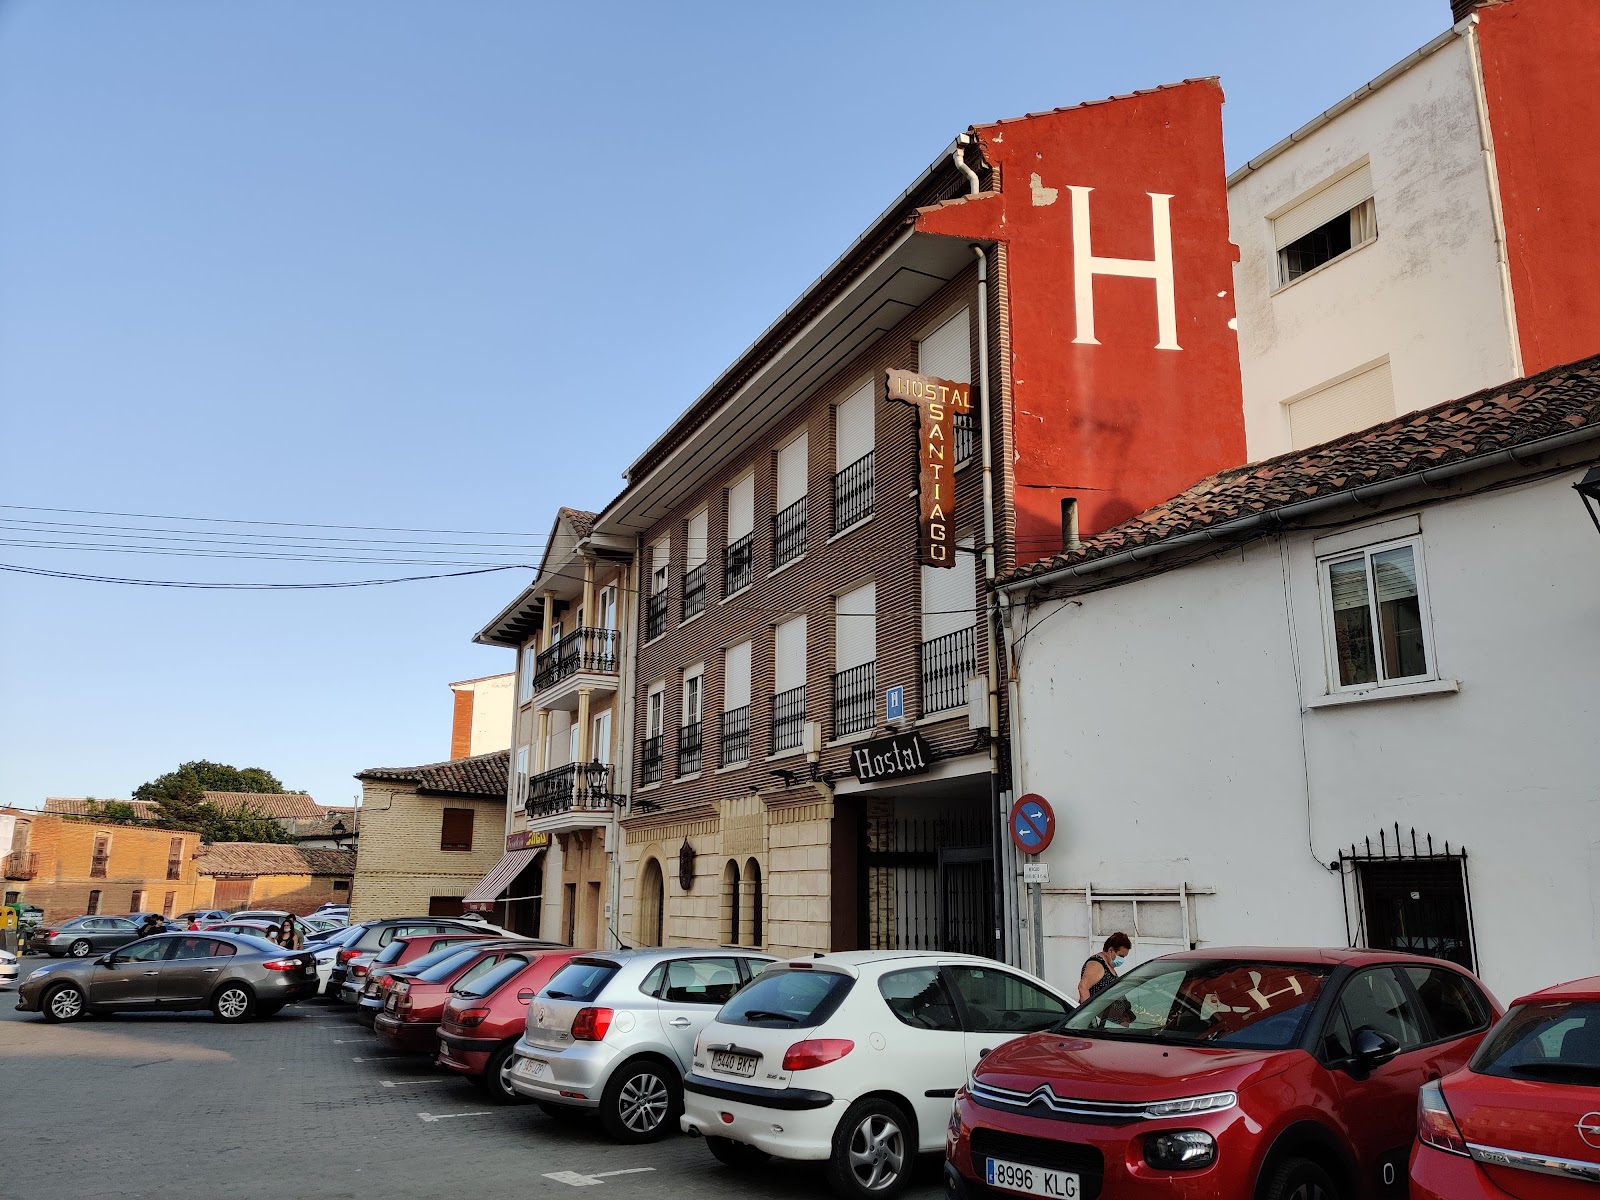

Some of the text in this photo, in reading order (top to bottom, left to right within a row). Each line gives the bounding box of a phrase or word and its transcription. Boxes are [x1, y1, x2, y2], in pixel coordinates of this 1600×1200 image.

[1066, 185, 1184, 350] H
[897, 377, 975, 409] HOSTAL
[929, 403, 946, 561] SANTIAGO
[853, 736, 926, 779] Hostal
[717, 1053, 735, 1070] 5440
[736, 1056, 755, 1073] BKF
[1478, 1151, 1511, 1164] ASTRA
[997, 1164, 1033, 1190] 8996
[1044, 1172, 1076, 1198] KLG
